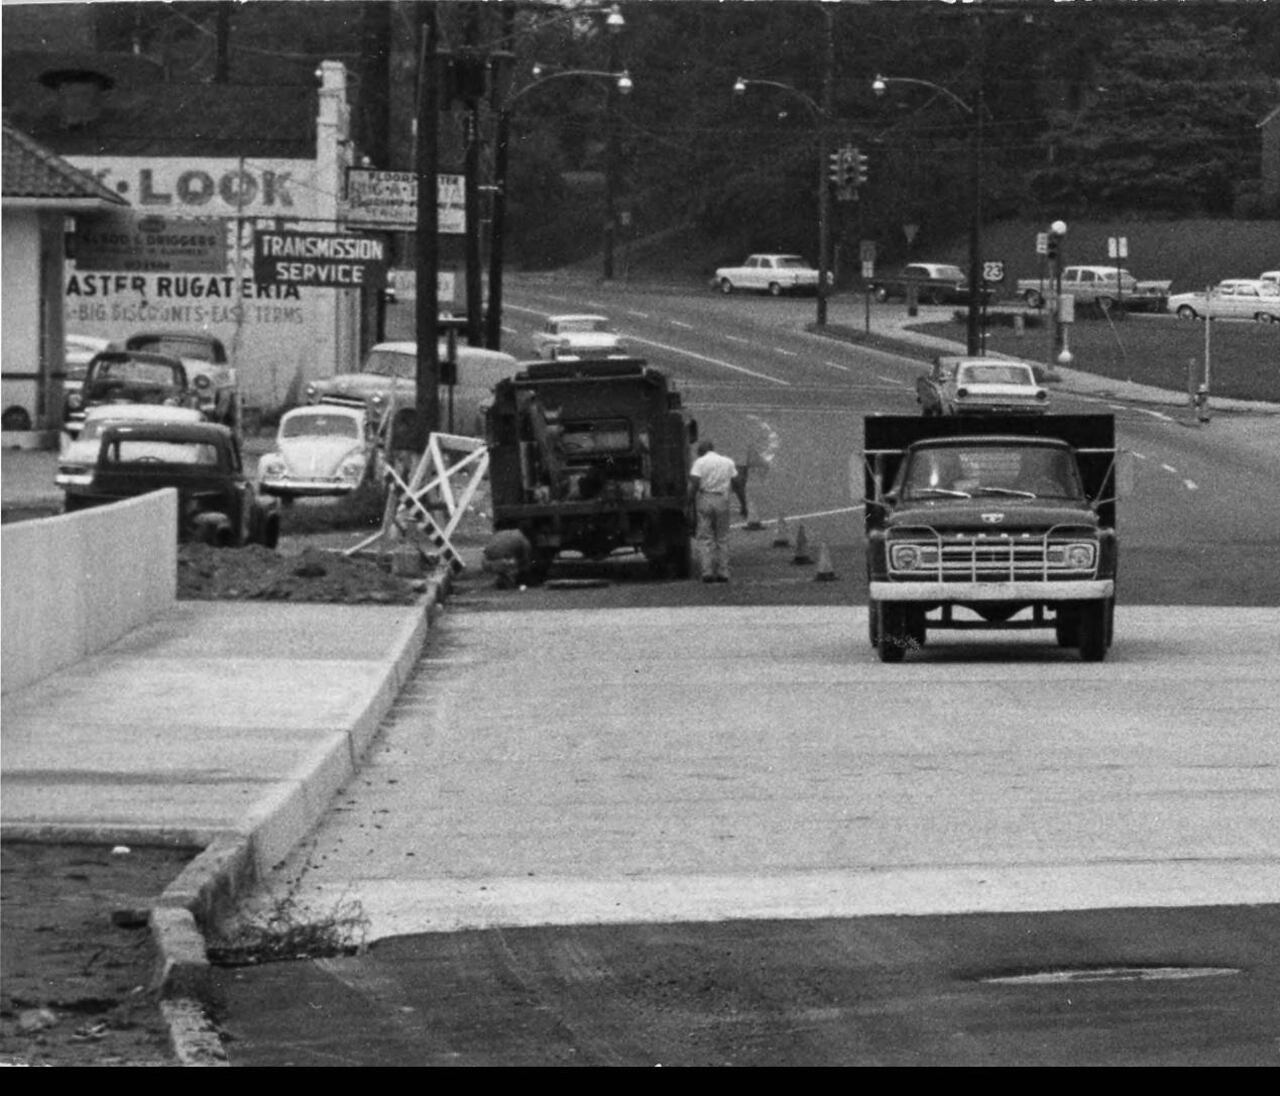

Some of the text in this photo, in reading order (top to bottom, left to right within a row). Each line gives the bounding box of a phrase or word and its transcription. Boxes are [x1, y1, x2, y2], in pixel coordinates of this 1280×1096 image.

[139, 168, 294, 206] LOOK
[262, 235, 382, 260] TRANSMISSION
[276, 262, 365, 283] SERVICE
